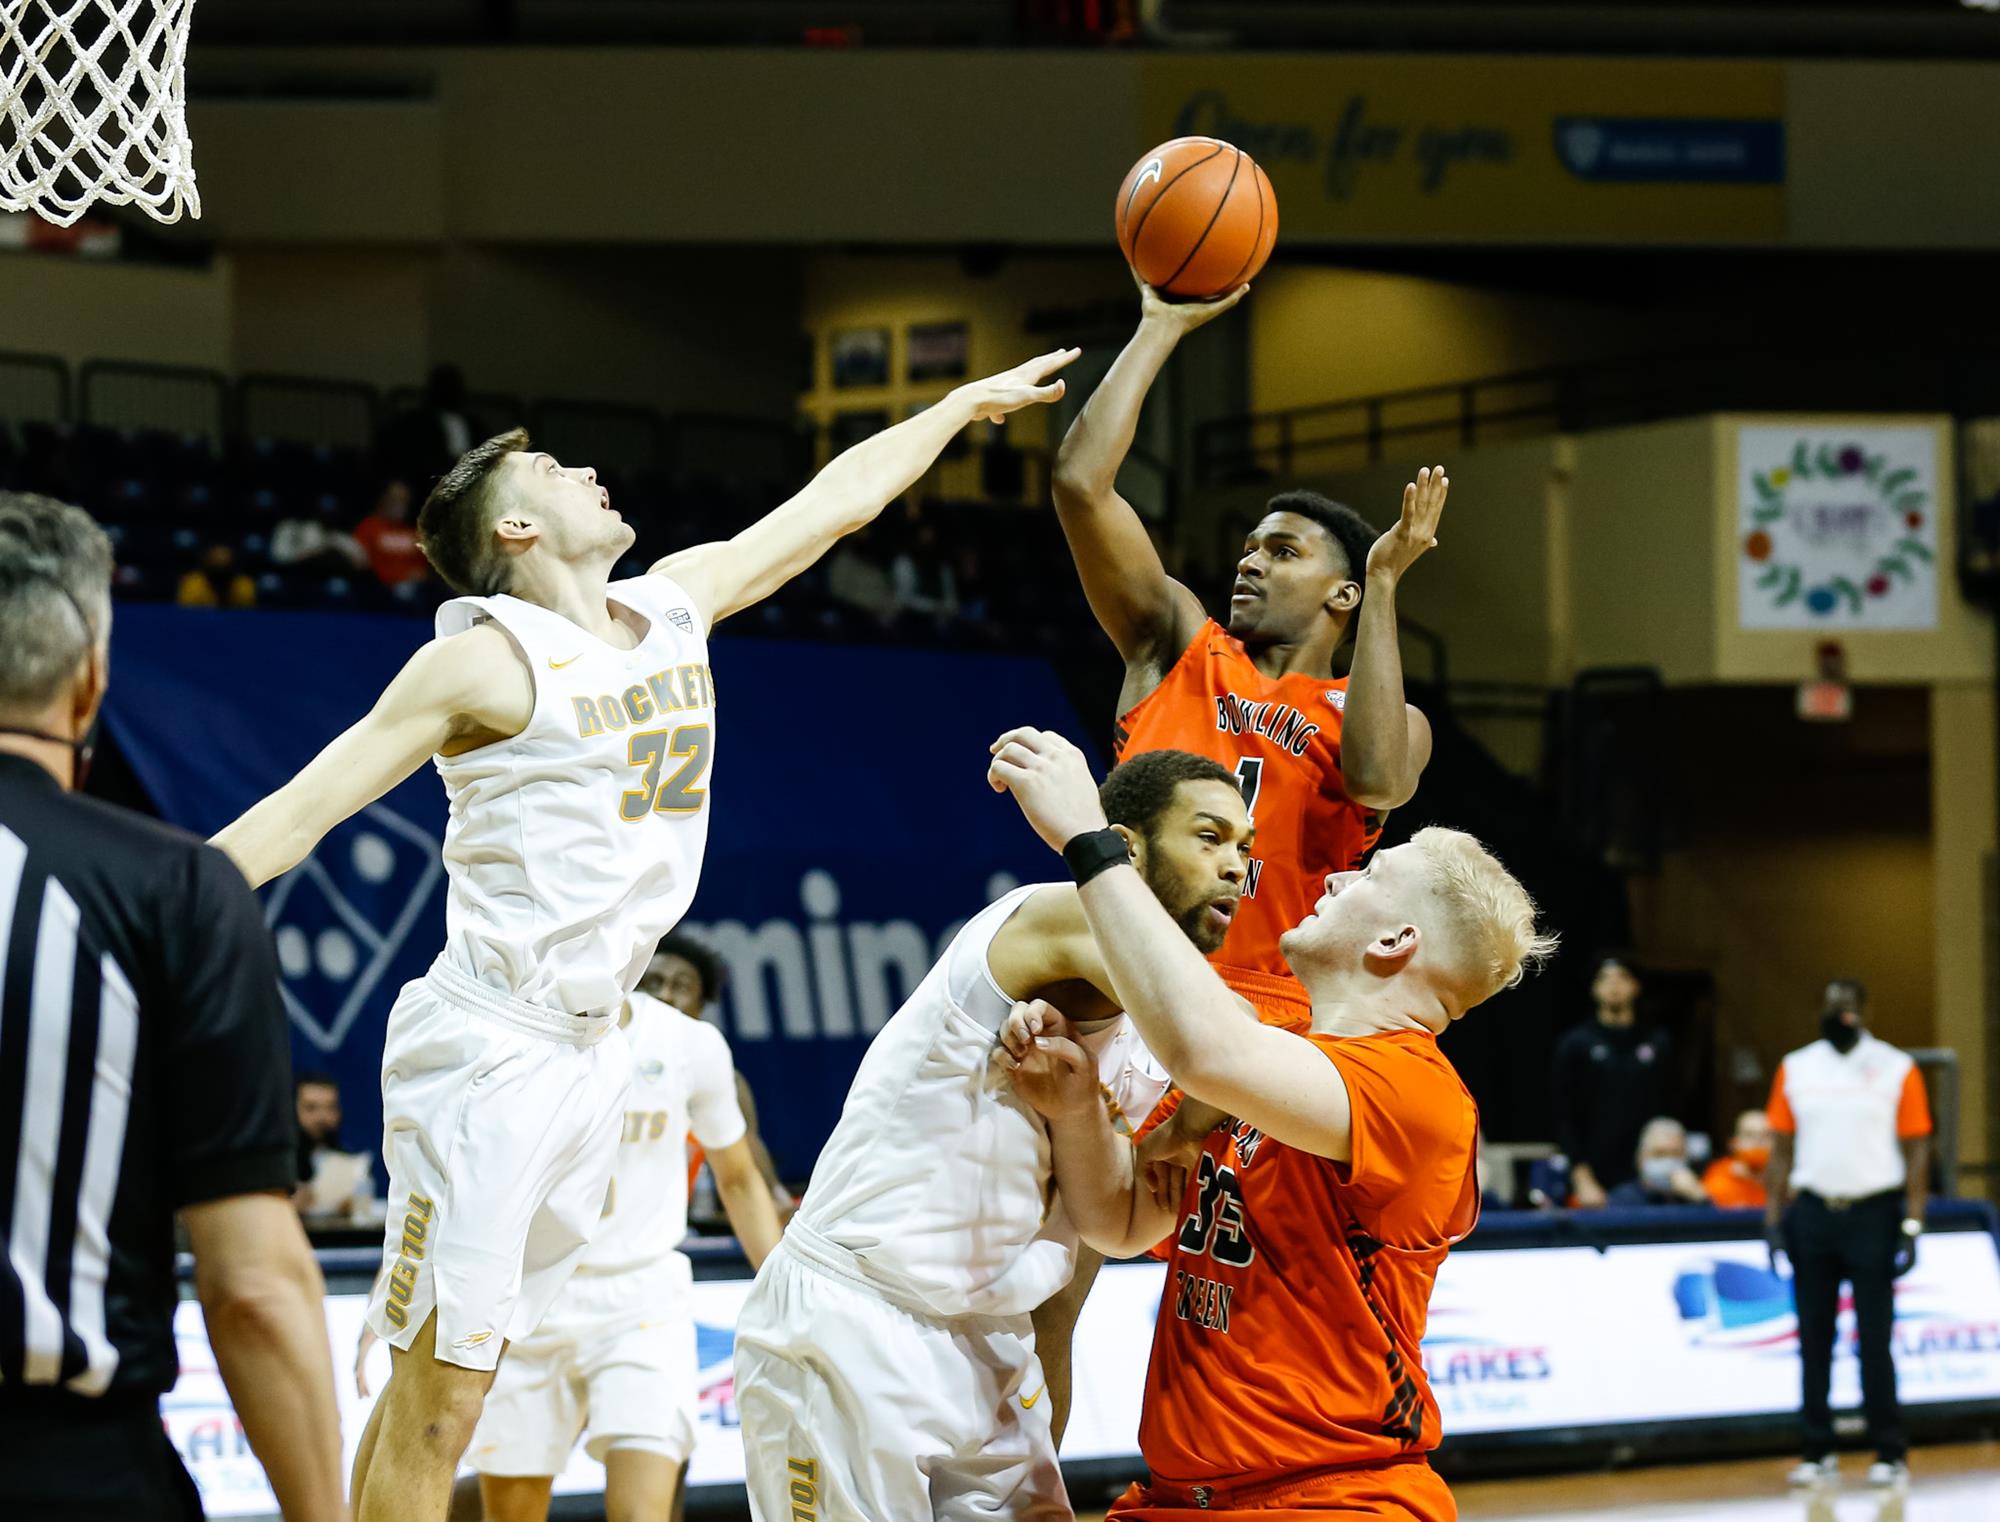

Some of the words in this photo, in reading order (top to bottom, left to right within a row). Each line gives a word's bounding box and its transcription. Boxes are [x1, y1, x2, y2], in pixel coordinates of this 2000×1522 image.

[619, 723, 710, 822] 32
[1215, 692, 1320, 756] BOWLING
[385, 1192, 434, 1329] TOLEDO
[1178, 1151, 1255, 1268] 35
